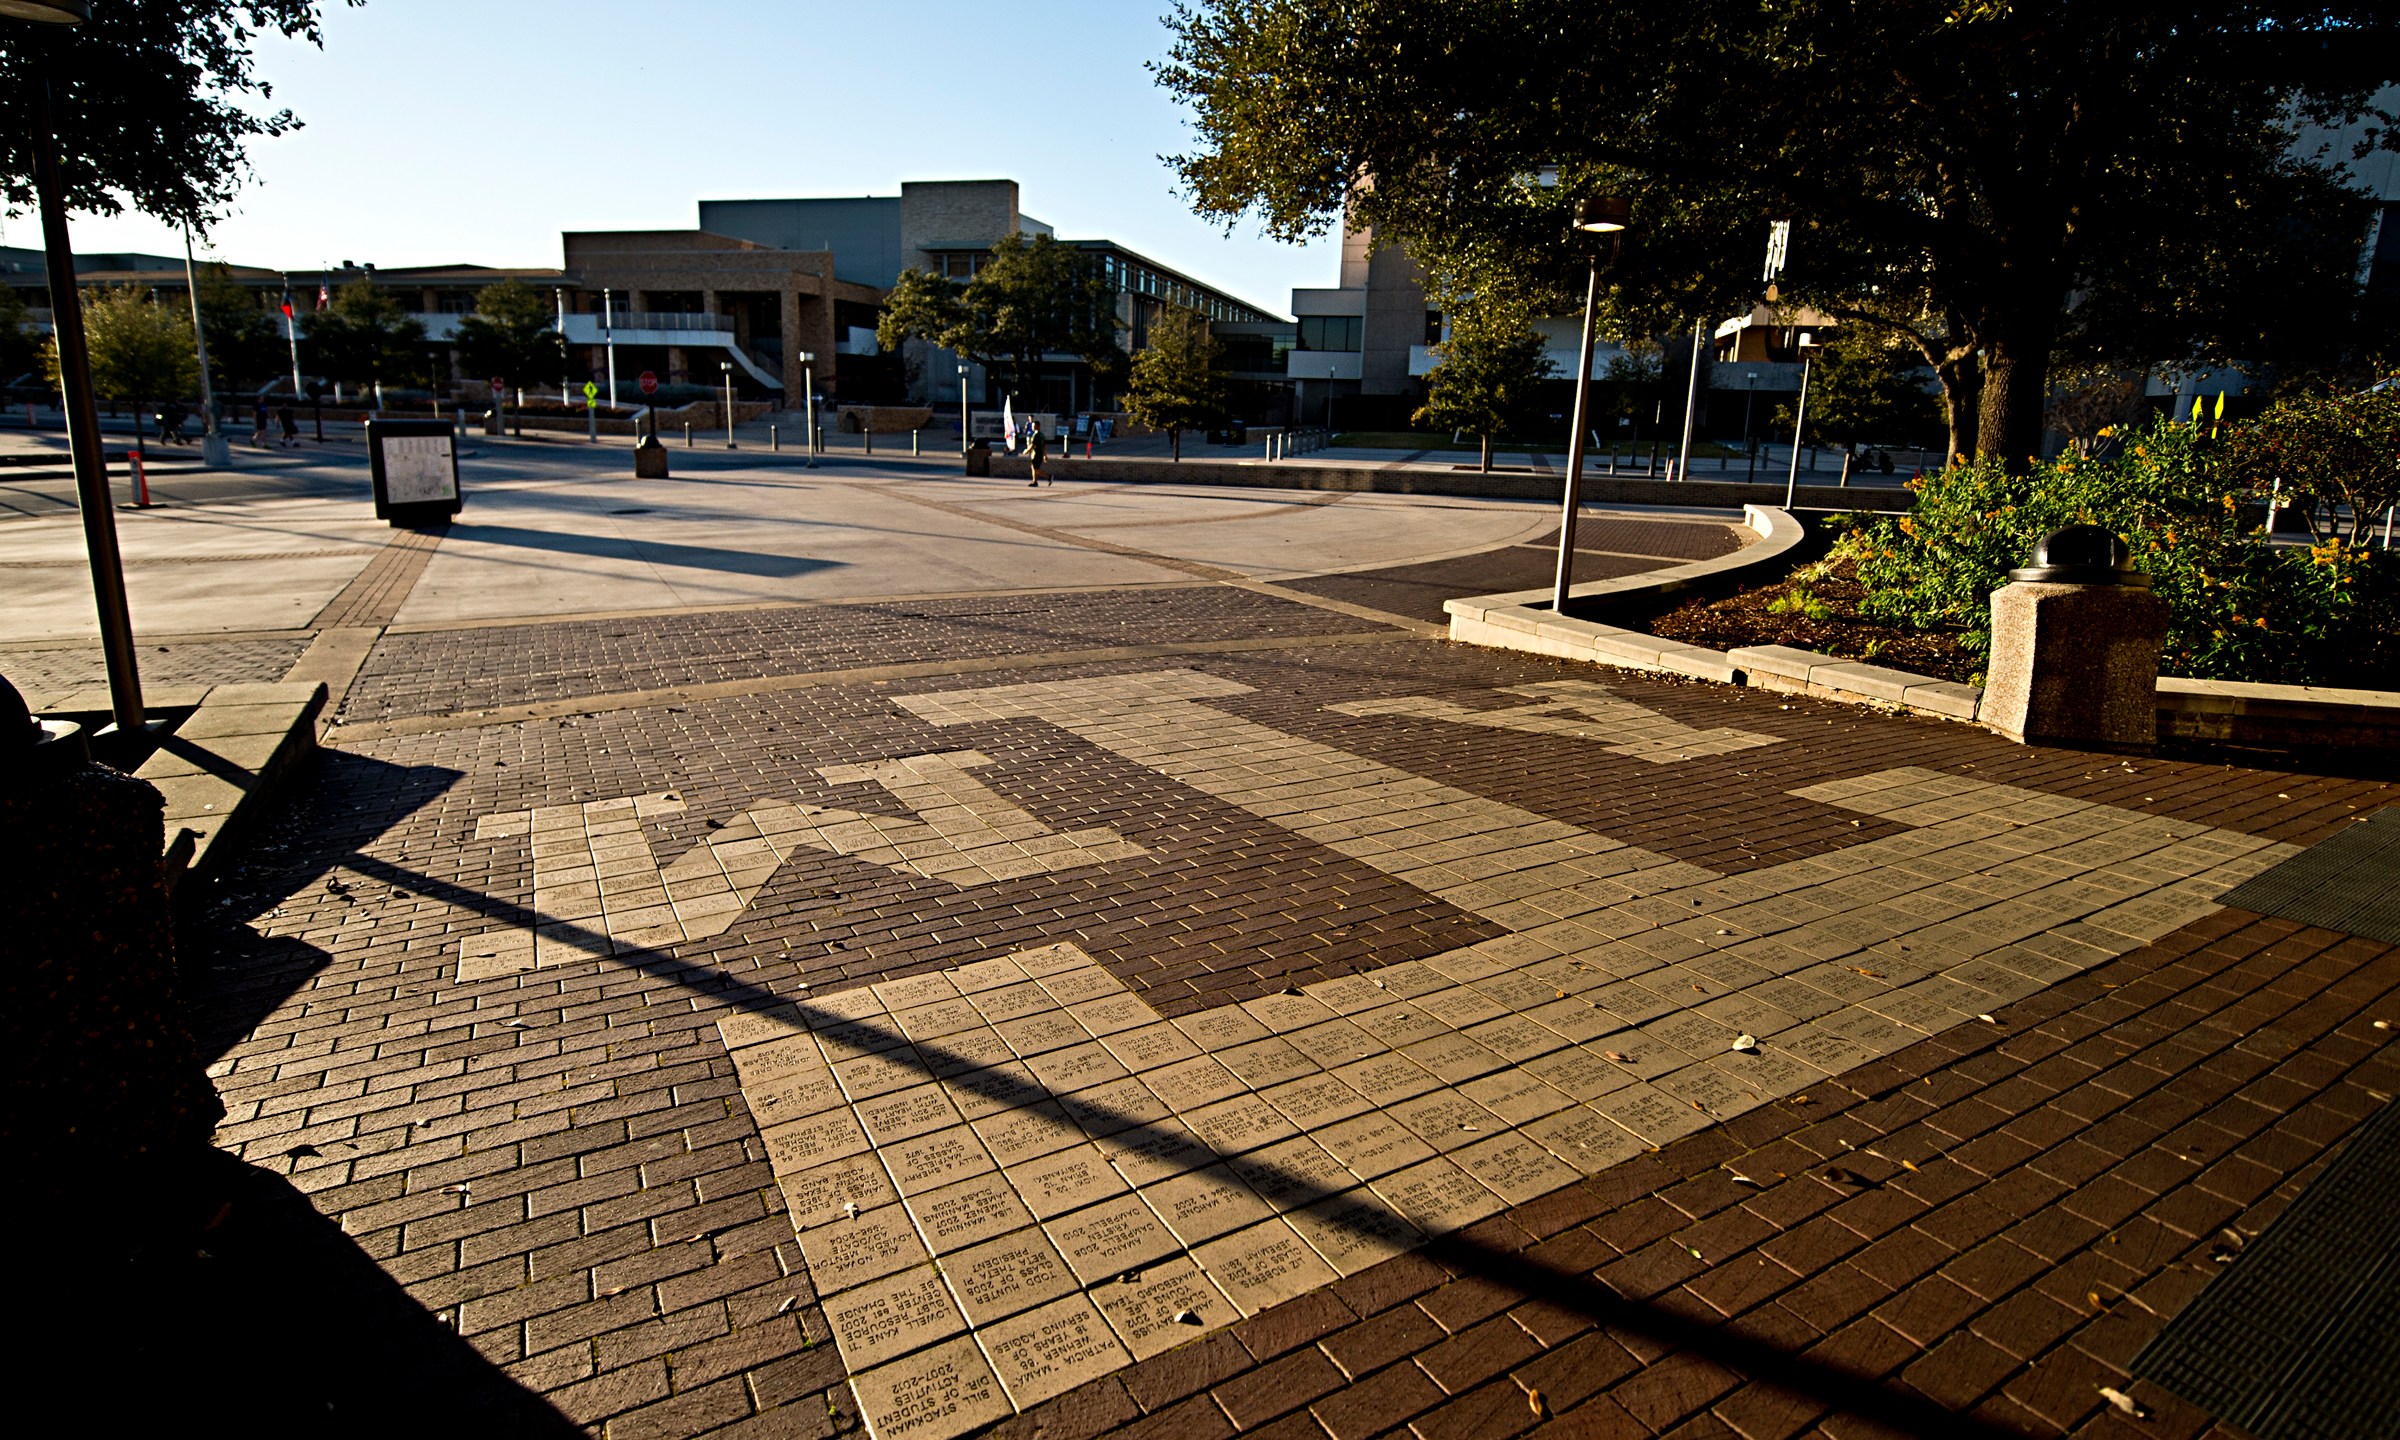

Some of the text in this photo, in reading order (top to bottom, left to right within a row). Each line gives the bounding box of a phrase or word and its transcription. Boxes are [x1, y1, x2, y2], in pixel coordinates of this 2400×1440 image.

[640, 378, 657, 386] STOP
[970, 1247, 1029, 1272] PRESIDENT
[1016, 1259, 1054, 1278] CLASS
[1018, 1251, 1047, 1266] BETA
[978, 1262, 1014, 1281] THETA
[890, 1287, 915, 1302] THE
[965, 1280, 996, 1296] 2008
[973, 1269, 1057, 1305] TODD HUNTER
[833, 1297, 886, 1322] CHANGE
[894, 1289, 942, 1311] CENTER
[838, 1314, 867, 1331] 2007
[844, 1298, 946, 1341] GLBT RESOURCE
[846, 1307, 952, 1352] LOWELL KANE '11
[991, 1310, 1091, 1355] SERVING AGGIES
[1030, 1330, 1072, 1352] YEARS
[1041, 1334, 1093, 1361] WEHNER
[1061, 1338, 1116, 1366] PATRICIA
[889, 1362, 954, 1394] 2007-2012
[892, 1373, 961, 1407] ACTIVITIES
[874, 1396, 936, 1428] STUDENT
[885, 1388, 991, 1438] BILL STACKMAN
